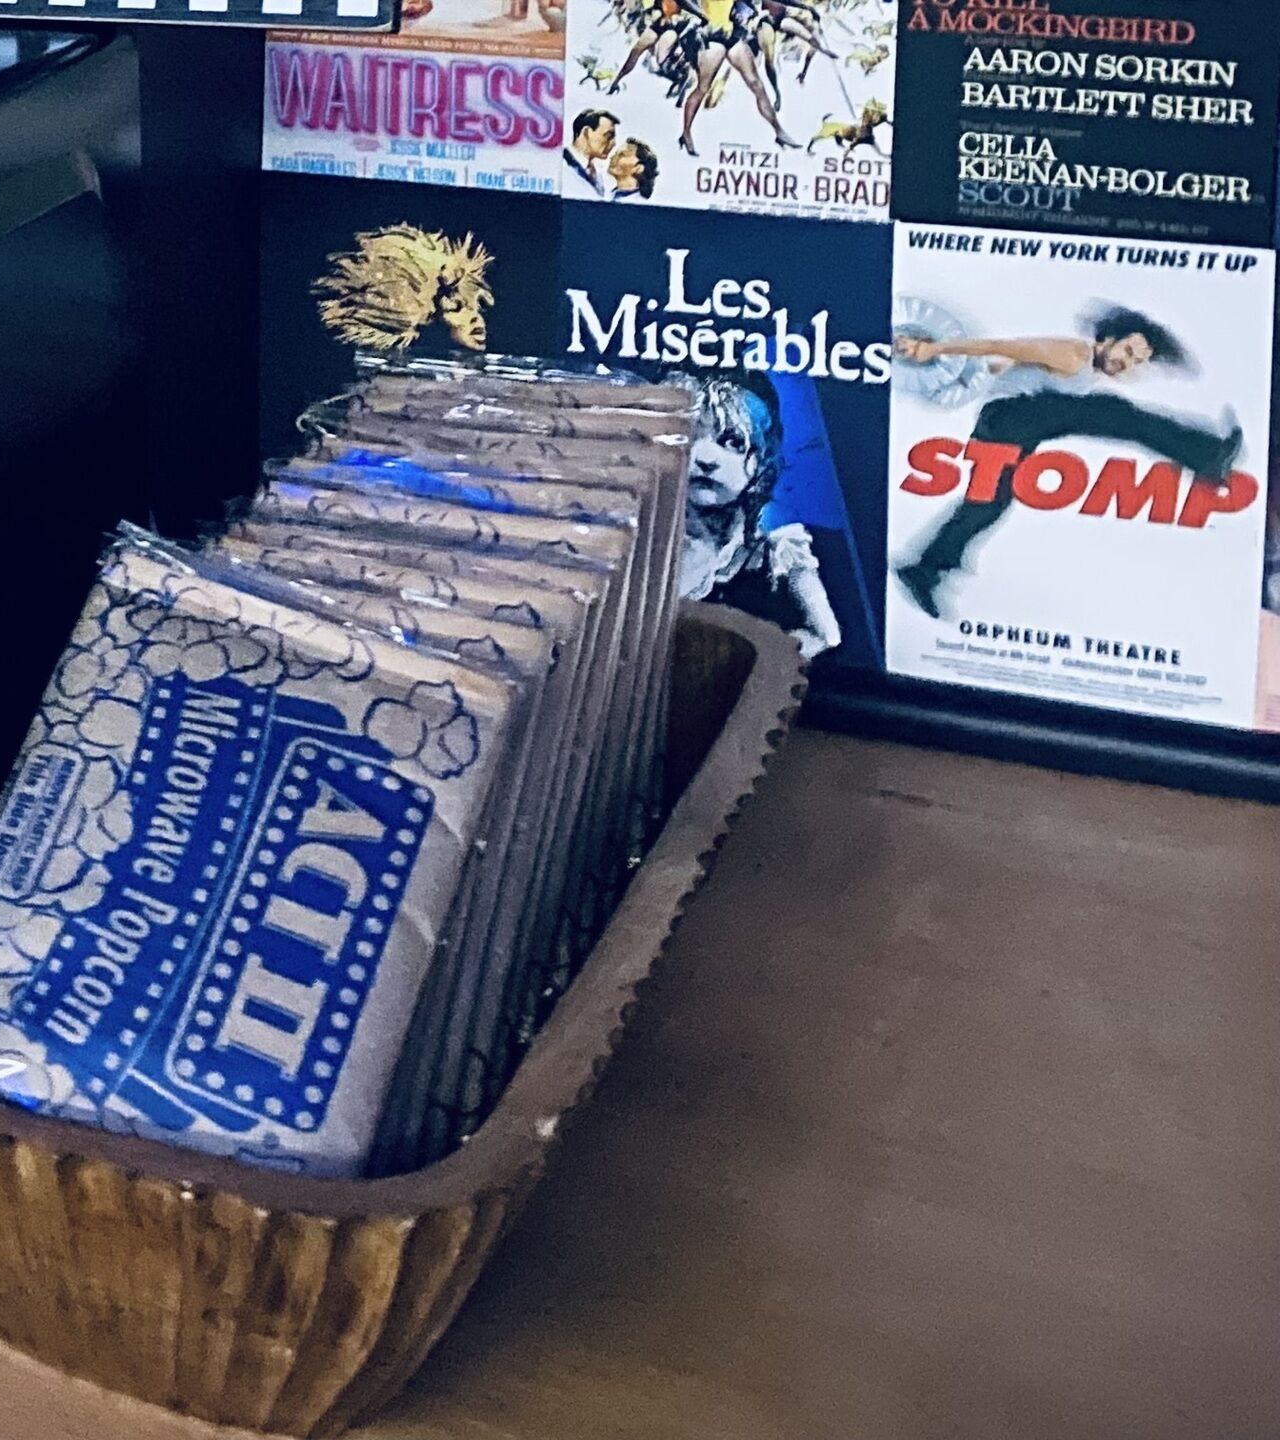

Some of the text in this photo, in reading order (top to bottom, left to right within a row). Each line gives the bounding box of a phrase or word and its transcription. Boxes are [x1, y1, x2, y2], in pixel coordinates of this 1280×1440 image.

[907, 9, 931, 30] A
[939, 10, 1196, 45] MOCKINGBIRD
[963, 46, 1239, 89] AARON SORKIN
[269, 47, 565, 150] WAITRESS
[961, 81, 1254, 126] BARTLETT SHER
[719, 151, 779, 169] MITZI
[958, 132, 1058, 161] CELIA
[697, 168, 798, 200] GAYNOR
[814, 176, 890, 207] BRAD
[958, 157, 1252, 203] KEENAN-BOLGER
[958, 181, 1081, 211] SCOUT
[907, 229, 1259, 274] WHERE NEW YORK TURNS IT UP
[663, 247, 771, 320] Les
[565, 288, 892, 385] Misérables
[899, 436, 1260, 530] STOMP
[959, 620, 1183, 666] ORPHEUM THEATRE
[45, 686, 243, 1046] Microwave Popcorn
[262, 777, 389, 966] ACT
